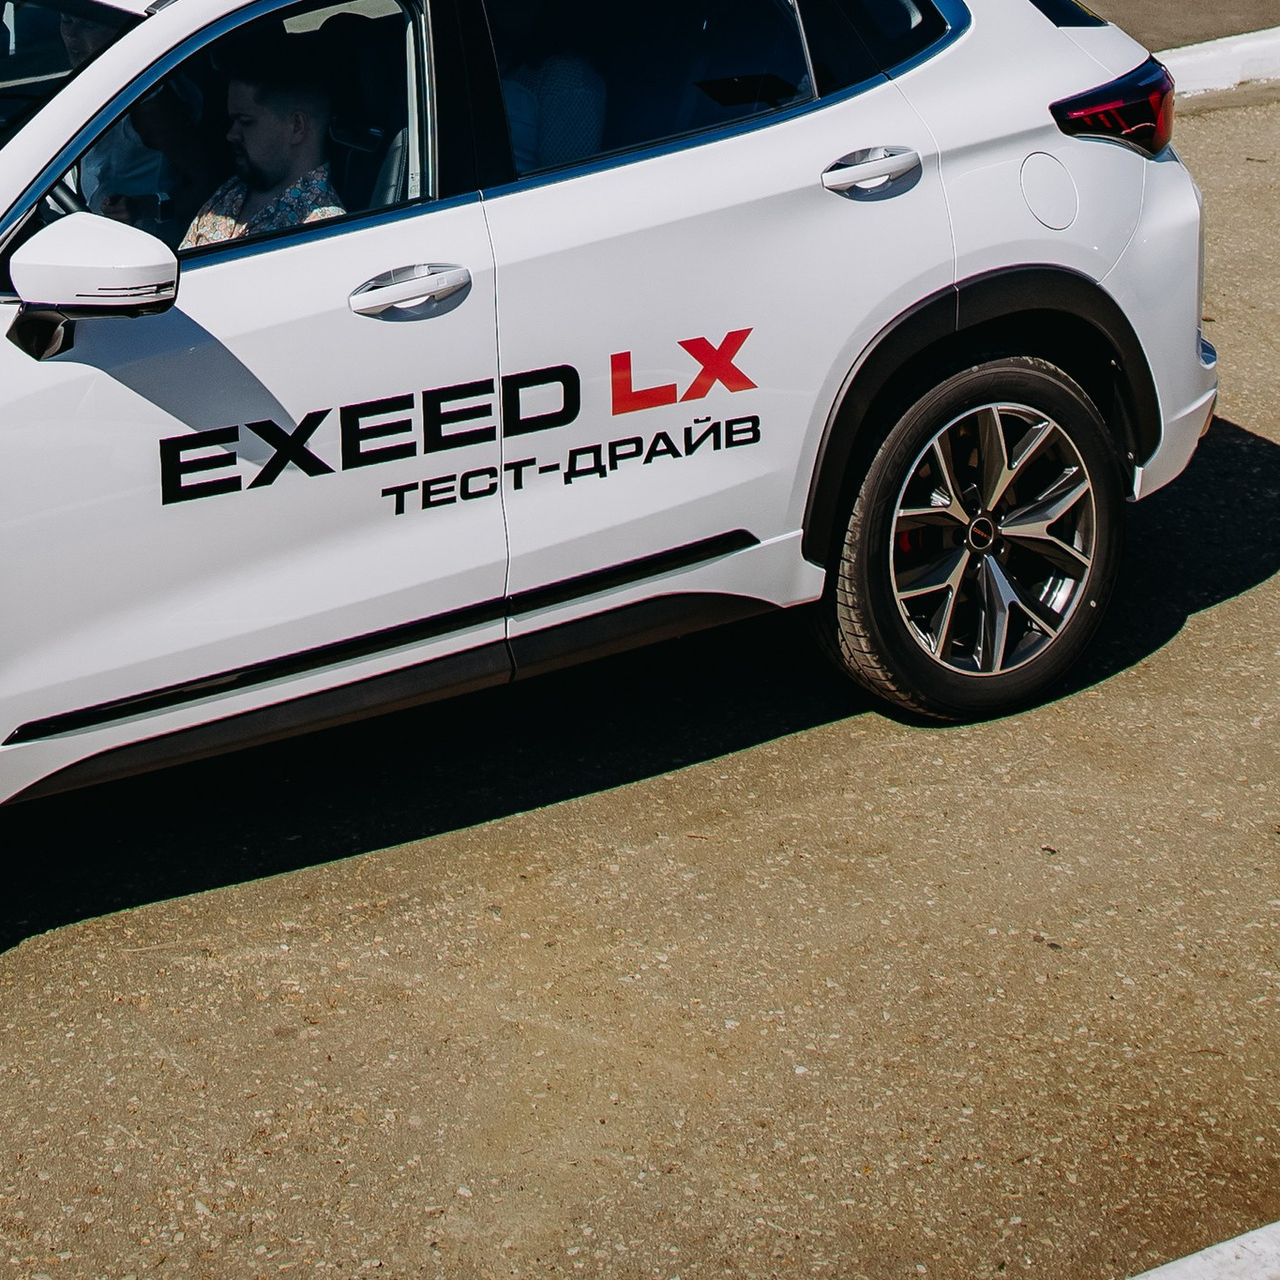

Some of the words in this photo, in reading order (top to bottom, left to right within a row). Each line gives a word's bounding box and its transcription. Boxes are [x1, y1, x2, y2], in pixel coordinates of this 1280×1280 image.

[160, 364, 581, 507] EXEED
[609, 327, 759, 416] LX
[381, 415, 762, 516] ТЕСТ-ДРАЙВ
